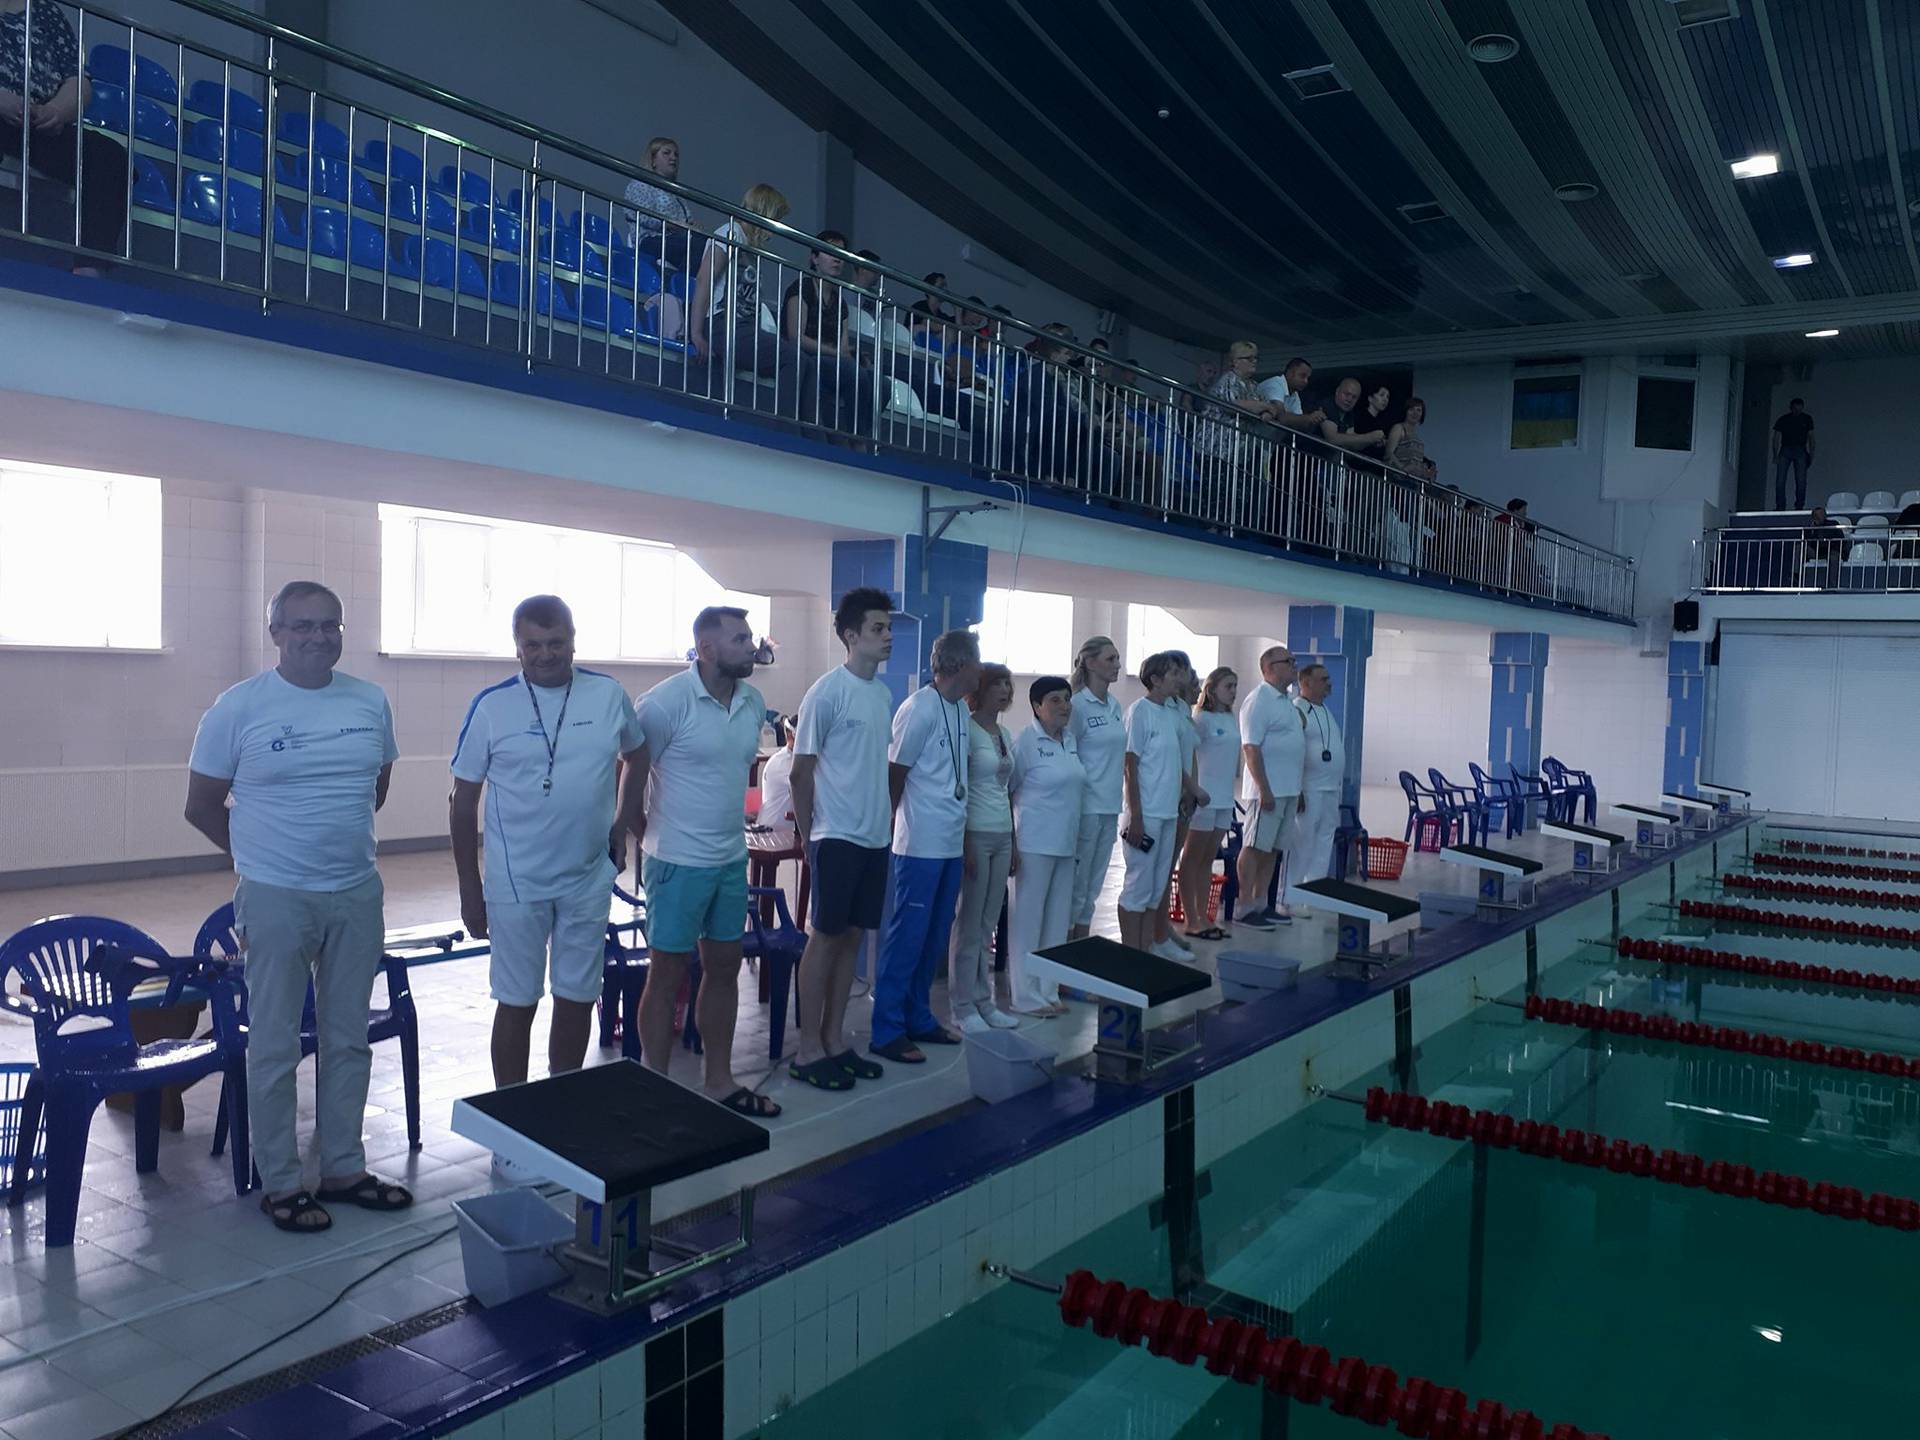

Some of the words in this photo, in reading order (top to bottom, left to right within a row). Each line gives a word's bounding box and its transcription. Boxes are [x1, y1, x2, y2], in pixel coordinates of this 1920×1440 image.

[1719, 801, 1729, 813] 8
[1639, 829, 1649, 843] 6
[1575, 851, 1587, 866] 5
[1482, 877, 1496, 897] 4
[1342, 925, 1358, 950] 3
[1102, 1005, 1125, 1040] 2
[583, 1200, 602, 1247] 1
[617, 1197, 638, 1249] 1
